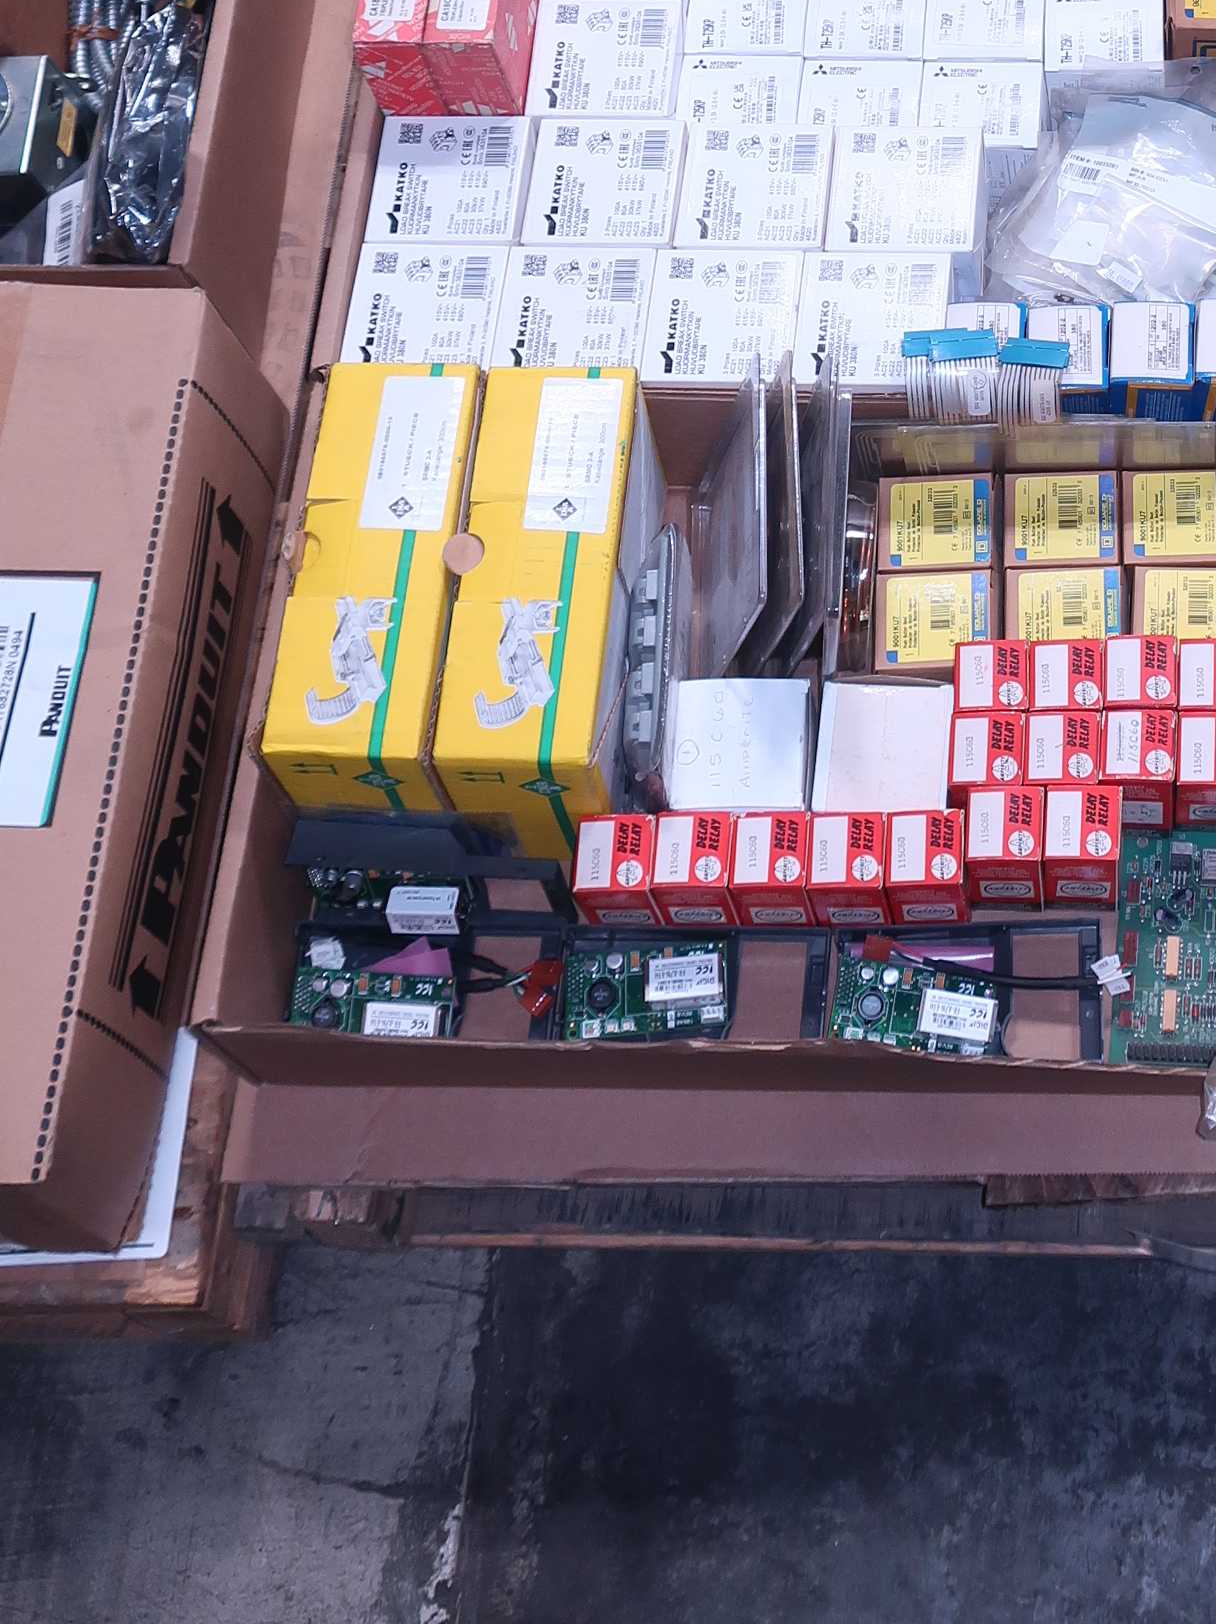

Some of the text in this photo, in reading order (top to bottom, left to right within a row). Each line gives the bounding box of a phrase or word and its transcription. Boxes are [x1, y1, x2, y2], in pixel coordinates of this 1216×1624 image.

[553, 41, 565, 79] KATKO
[396, 162, 408, 202] KATKO
[553, 165, 565, 204] KATKO
[704, 169, 715, 209] KATKO
[370, 293, 382, 335] KATKO
[518, 295, 532, 337] KATKO
[667, 298, 681, 340] KATKO
[818, 300, 830, 342] KATKO
[996, 647, 1007, 675] DELAY
[1009, 647, 1020, 677] RELAY
[1072, 646, 1082, 675] DELAY
[1084, 647, 1094, 677] RELAY
[38, 663, 73, 738] PANDUIT
[992, 719, 1002, 749] DELAY
[1004, 721, 1015, 753] RELAY
[1146, 714, 1156, 742] DELAY
[1158, 715, 1169, 746] RELAY
[140, 560, 236, 947] PANDUIT
[1008, 794, 1019, 823] DELAY
[1022, 794, 1032, 826] RELAY
[1086, 793, 1097, 823] DELAY
[1098, 794, 1109, 826] RELAY
[617, 823, 629, 854] DELAY
[630, 823, 642, 855] RELAY
[697, 818, 706, 848] DELAY
[708, 818, 721, 850] RELAY
[931, 817, 942, 847] DELAY
[944, 818, 954, 850] RELAY
[695, 966, 713, 976] ICC
[415, 983, 433, 996] ICC
[411, 1020, 429, 1030] ICC
[968, 1008, 987, 1019] ICC
